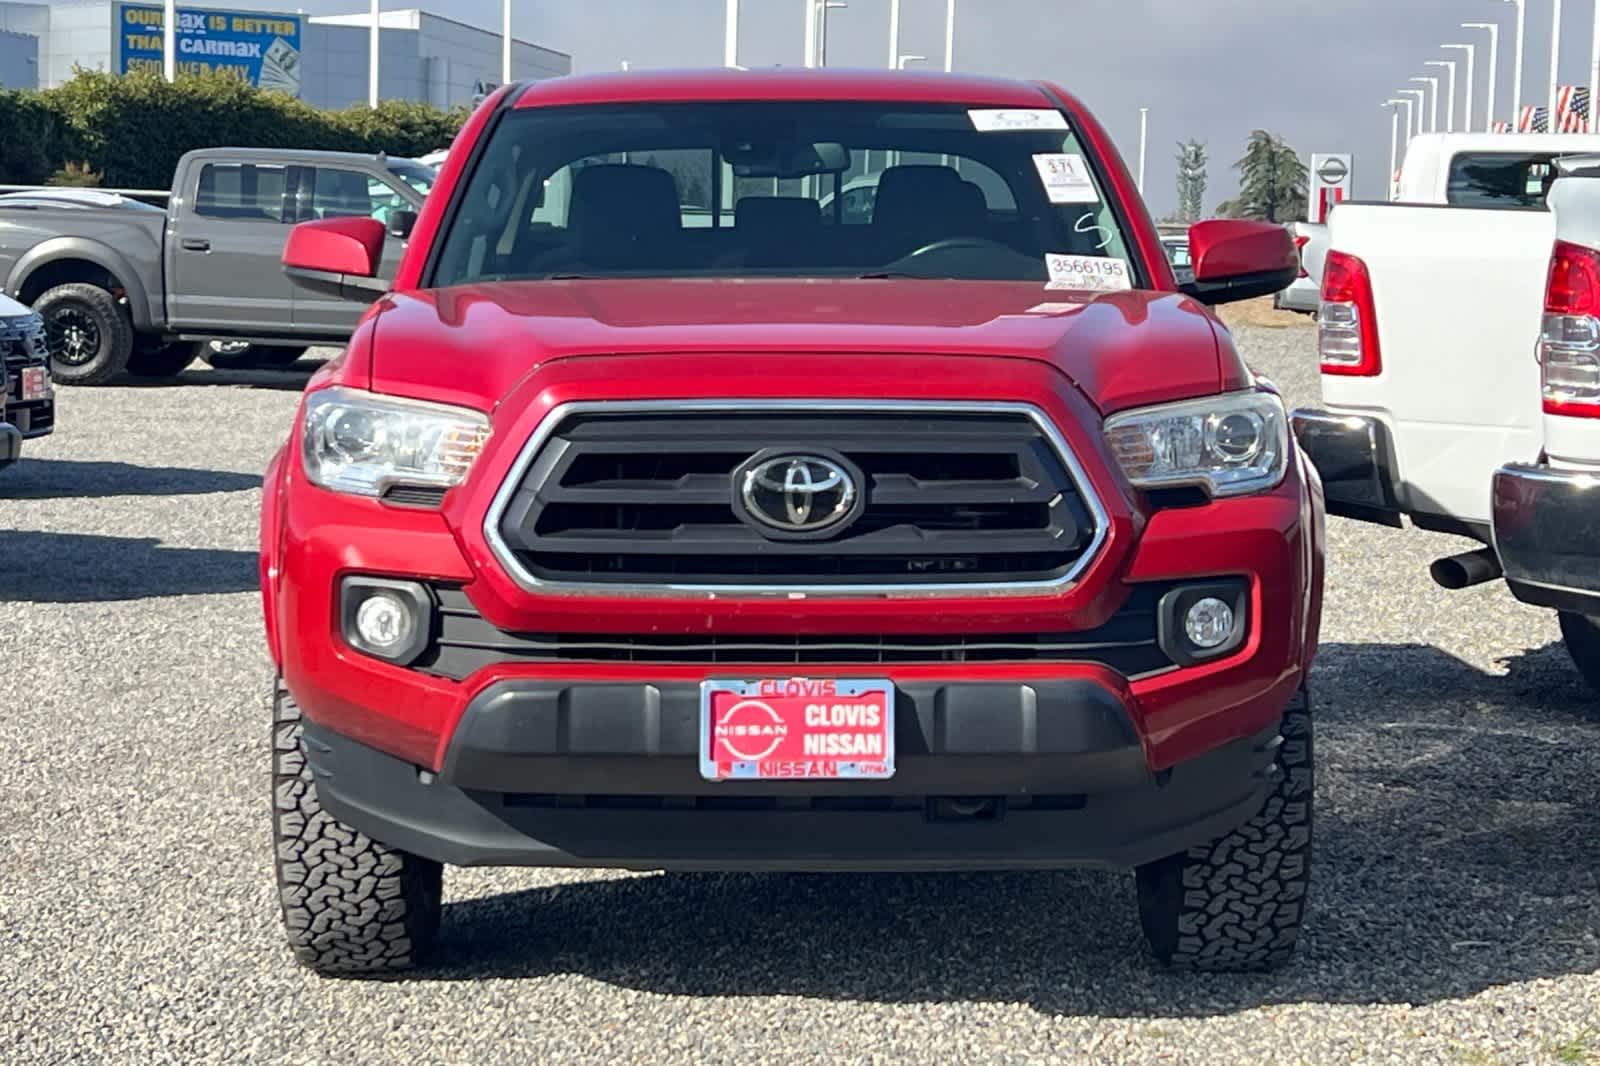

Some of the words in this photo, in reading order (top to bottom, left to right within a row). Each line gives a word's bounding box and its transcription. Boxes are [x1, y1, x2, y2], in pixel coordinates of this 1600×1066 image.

[126, 9, 161, 25] OUR
[208, 15, 227, 31] IS
[231, 17, 296, 36] BETTER
[127, 34, 164, 51] THA
[1052, 258, 1124, 277] 3566195
[760, 680, 836, 697] CLOVIS
[804, 704, 881, 727] CLOVIS
[714, 725, 788, 736] NISSAN
[803, 733, 882, 756] NISSAN
[759, 762, 837, 777] NISSAN
